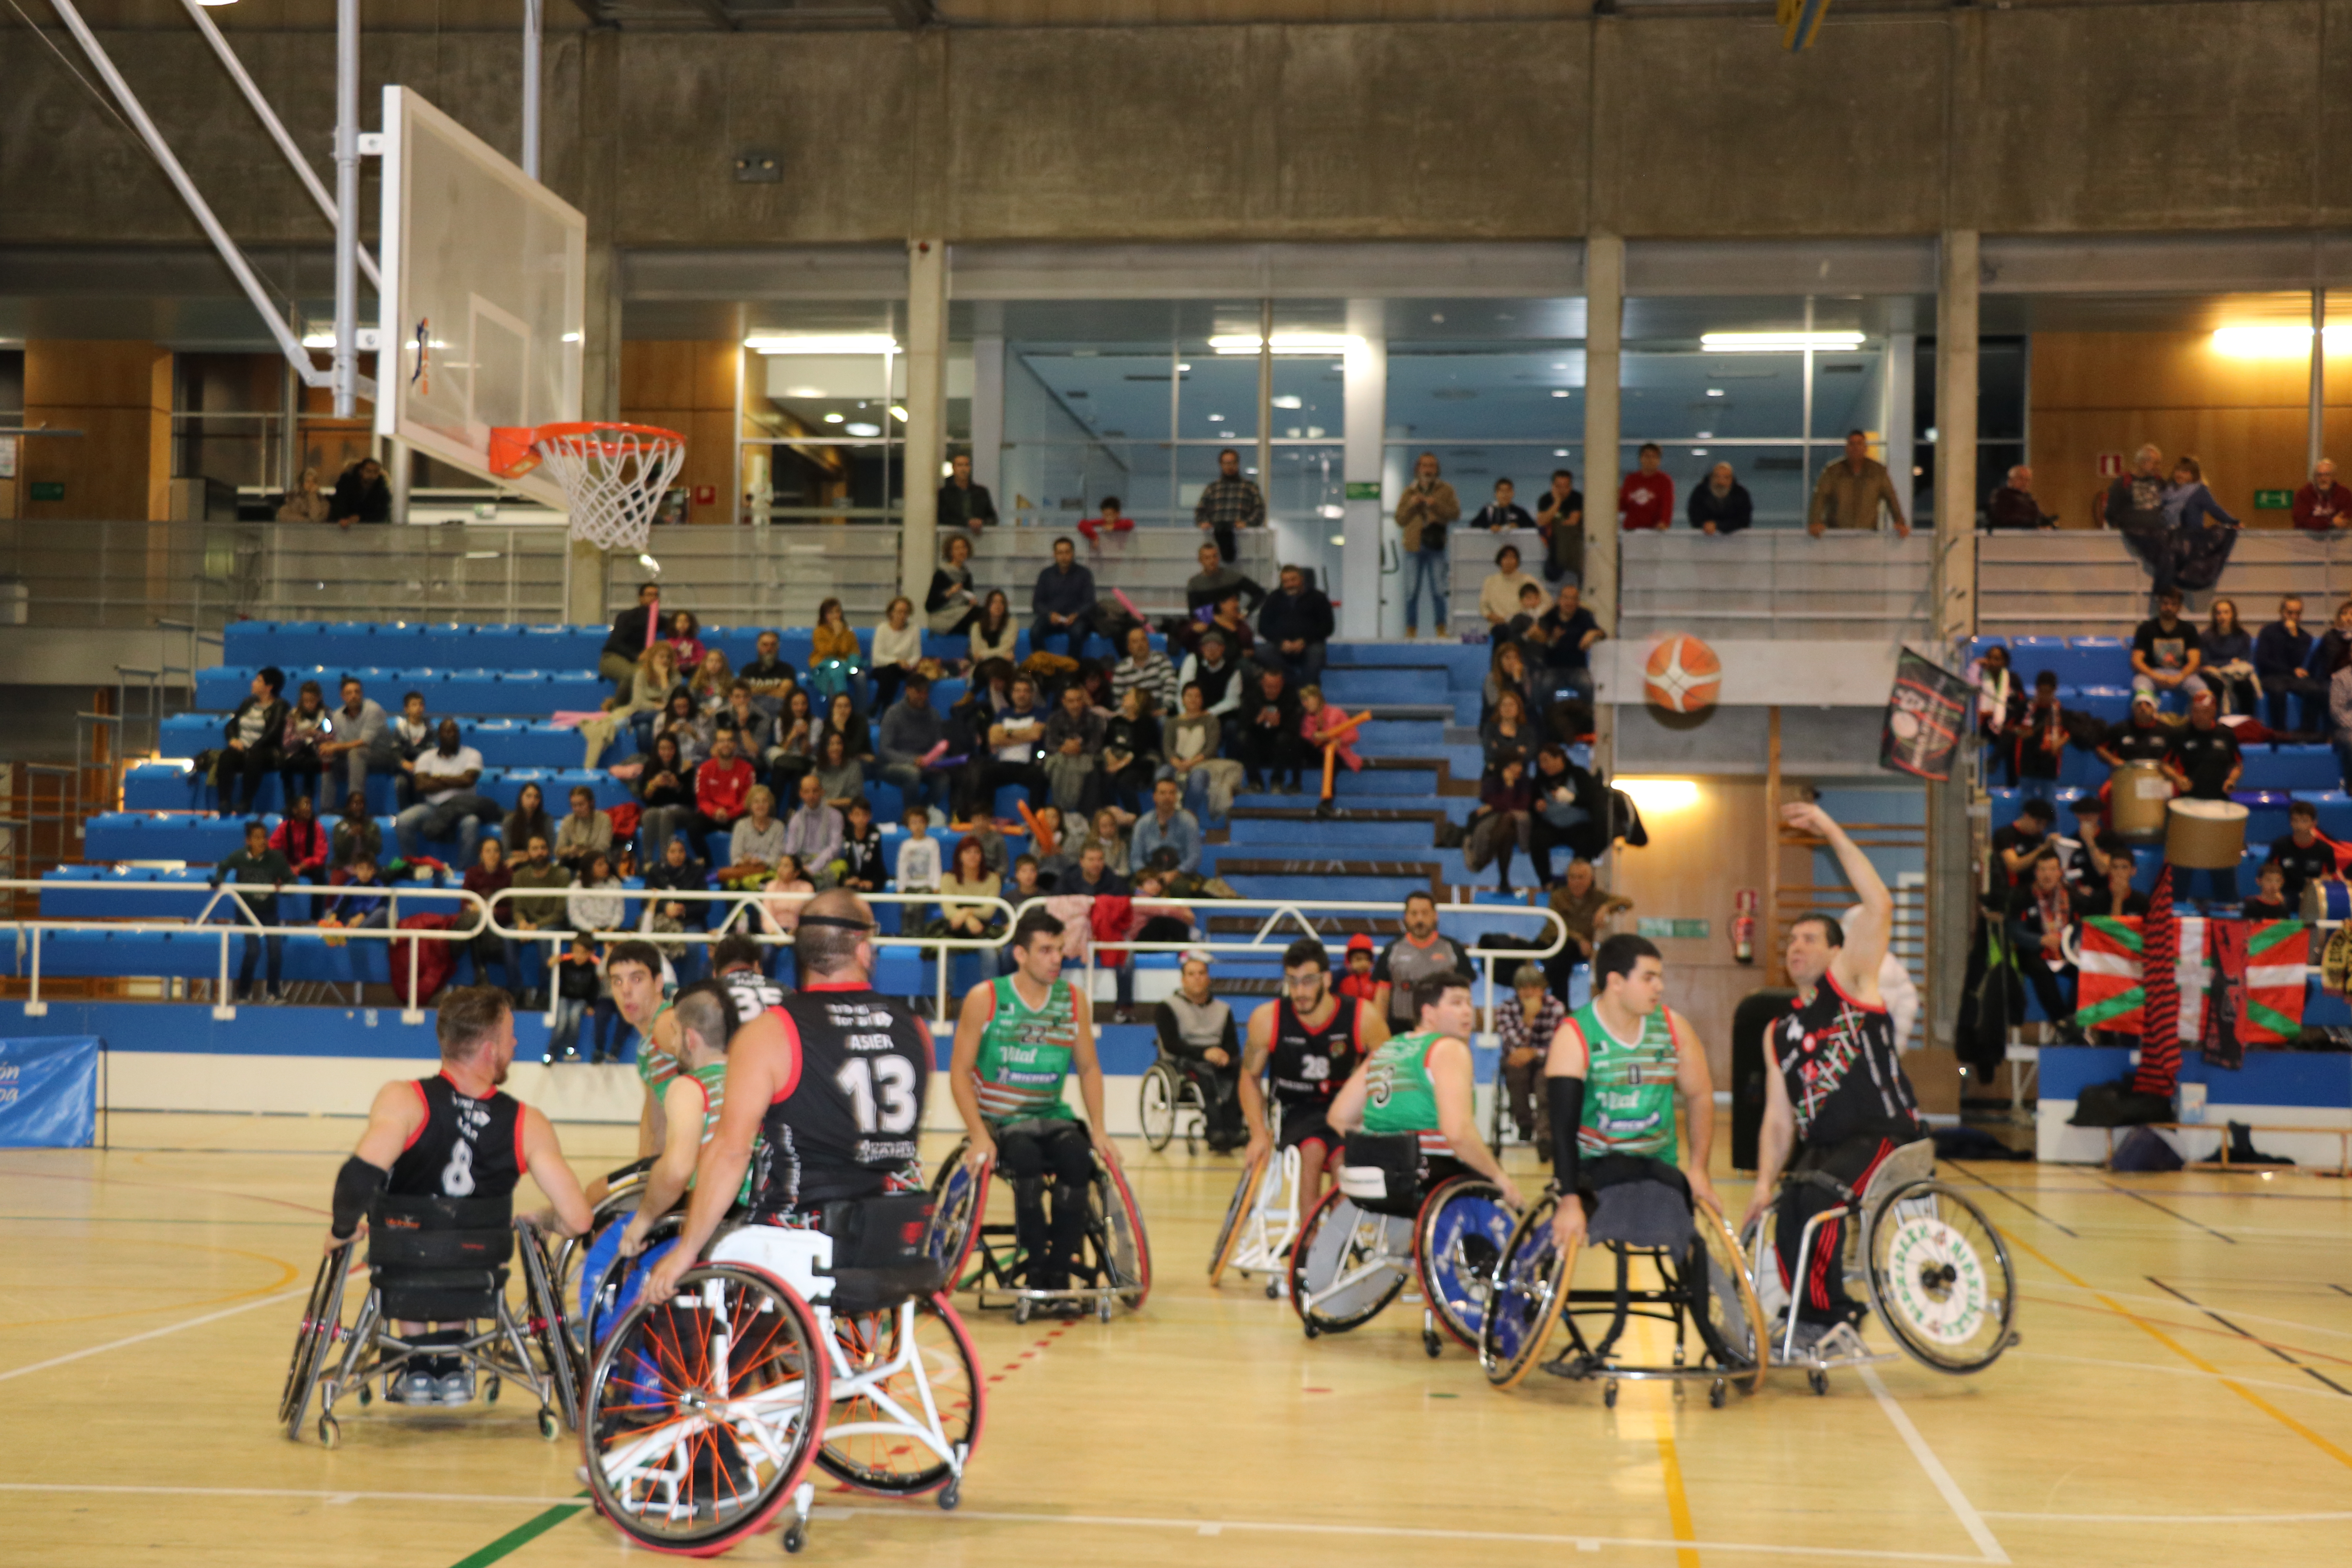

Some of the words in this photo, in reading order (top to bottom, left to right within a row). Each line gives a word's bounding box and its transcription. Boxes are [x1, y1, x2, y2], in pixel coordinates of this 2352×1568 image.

[848, 1033, 895, 1051] ASIER
[999, 1045, 1038, 1064] Vital
[835, 1054, 918, 1135] 13
[443, 1138, 475, 1196] 8
